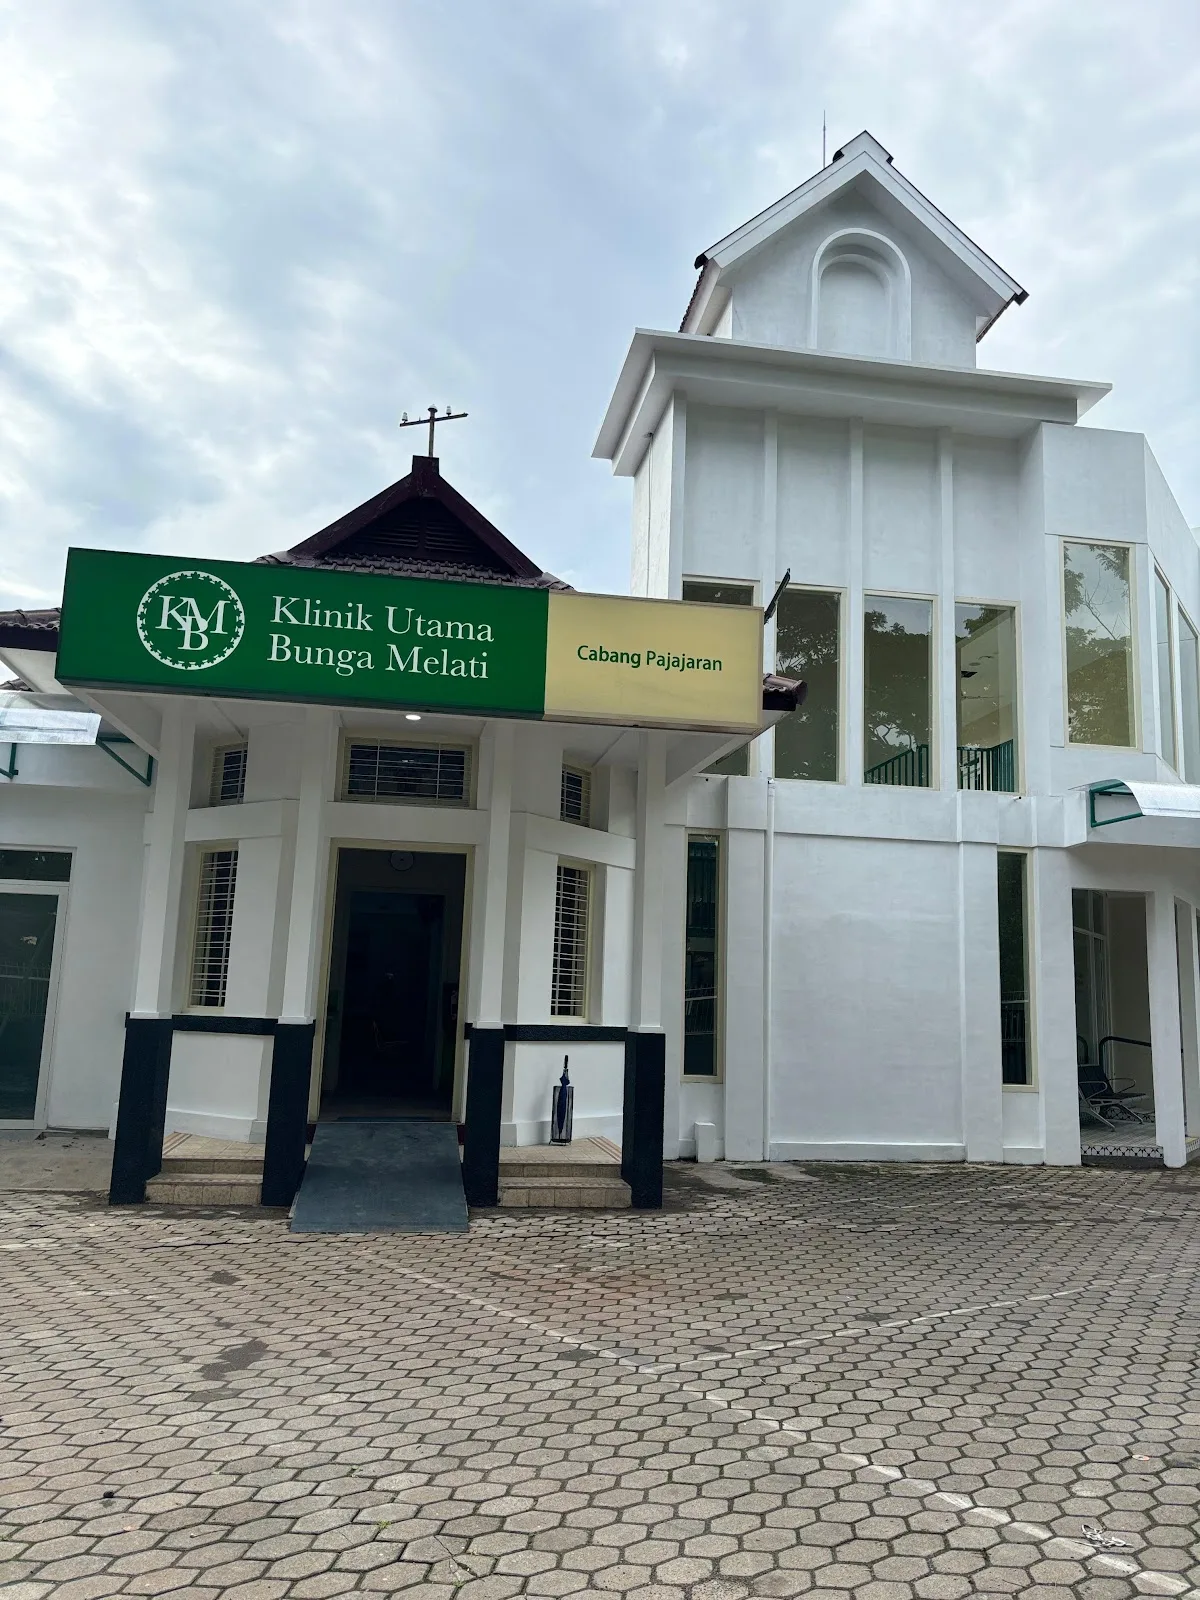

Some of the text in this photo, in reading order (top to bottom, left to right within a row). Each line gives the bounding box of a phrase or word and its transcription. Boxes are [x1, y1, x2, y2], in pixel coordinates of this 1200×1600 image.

[271, 596, 495, 643] Klinik Utama
[266, 633, 490, 680] Bunga Melati
[577, 645, 722, 672] Cabang Pajajaran
